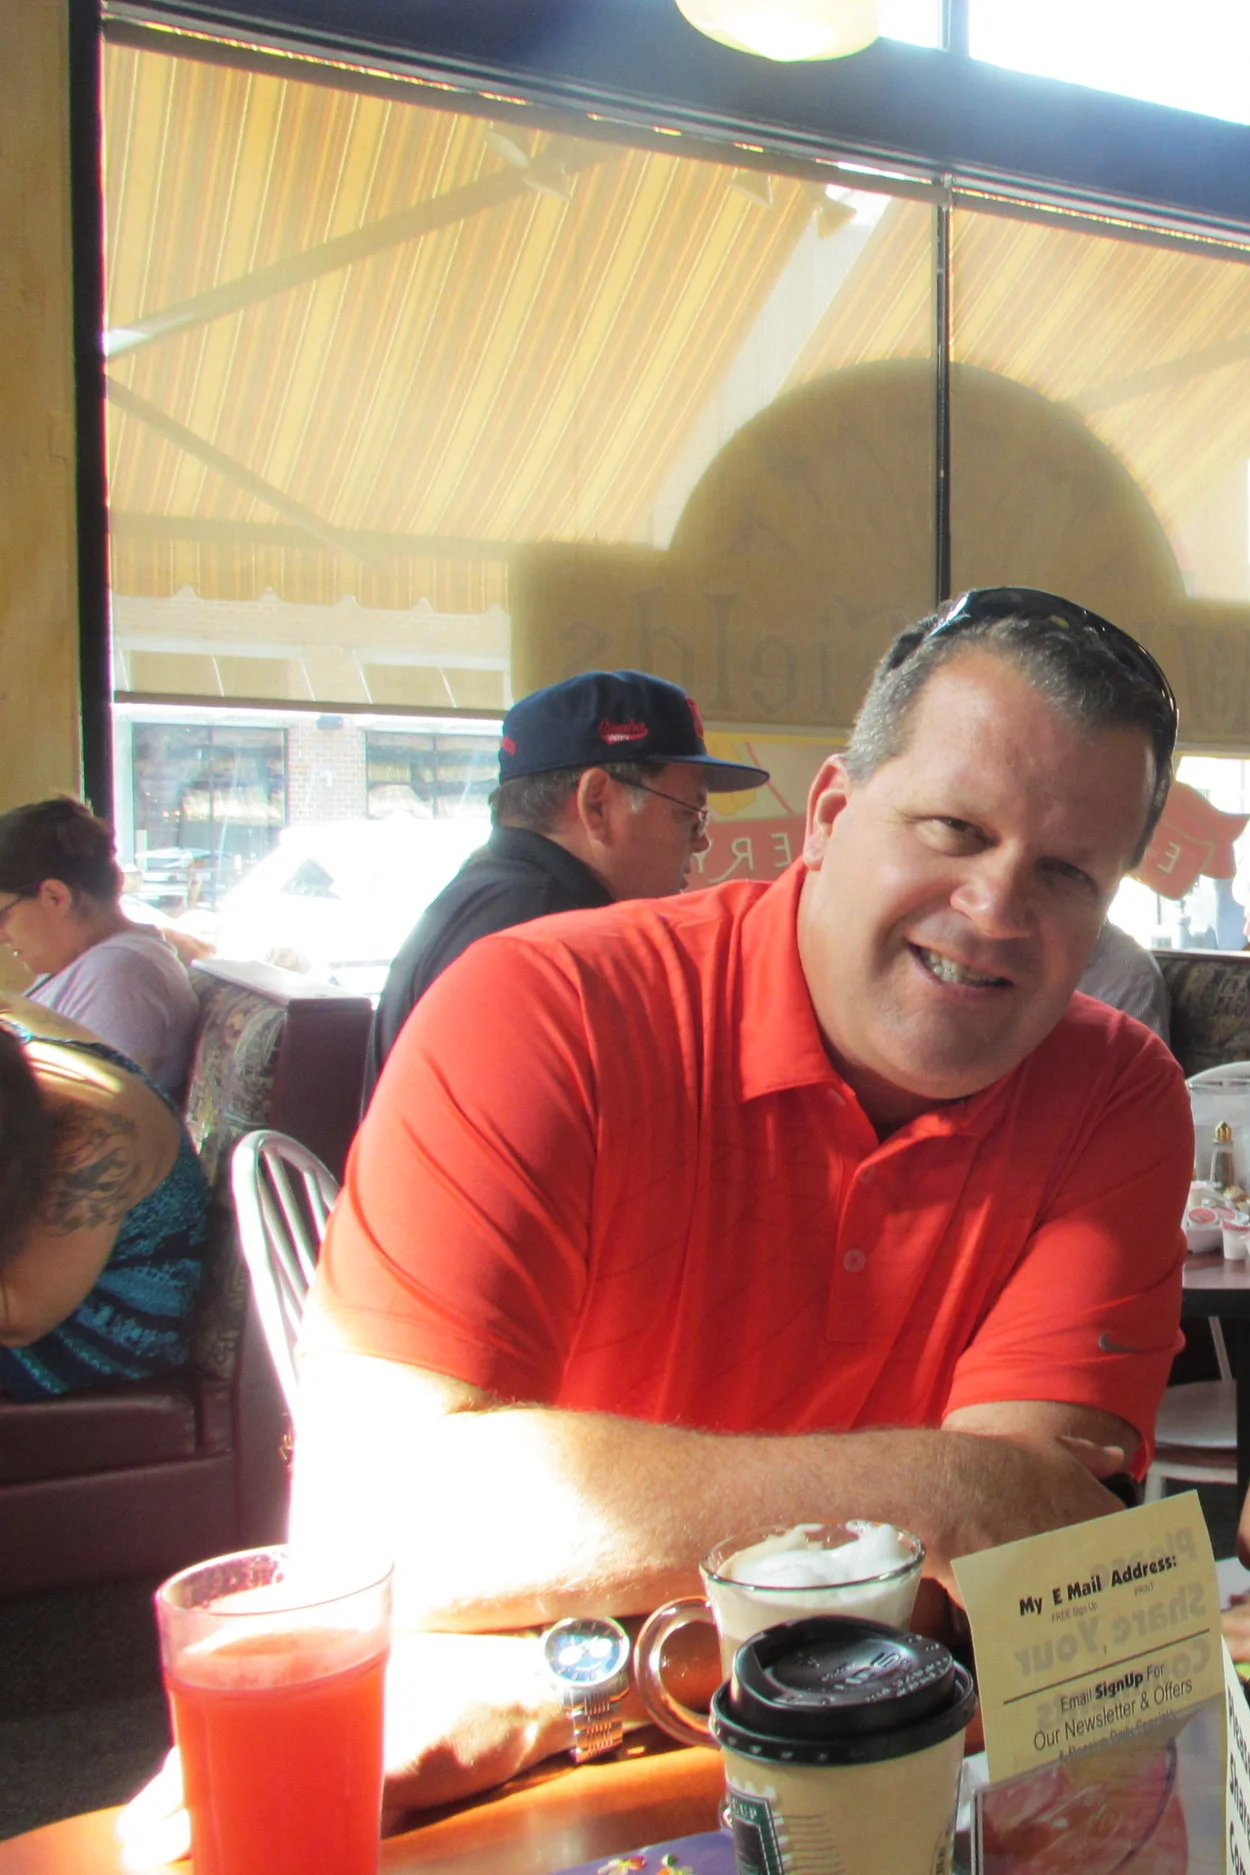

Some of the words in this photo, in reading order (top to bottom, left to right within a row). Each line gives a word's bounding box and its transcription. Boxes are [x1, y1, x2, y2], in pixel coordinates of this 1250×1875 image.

[1019, 1595, 1043, 1616] My
[1052, 1587, 1063, 1606] E
[1067, 1575, 1102, 1600] Mail
[1111, 1555, 1177, 1588] Address:
[1034, 1729, 1061, 1751] Our
[1065, 1699, 1136, 1741] Newsletter
[1140, 1691, 1150, 1711] &
[1154, 1679, 1193, 1705] Offers
[1060, 1688, 1093, 1712] Email
[1095, 1671, 1144, 1699] SignUp
[1147, 1663, 1165, 1681] For
